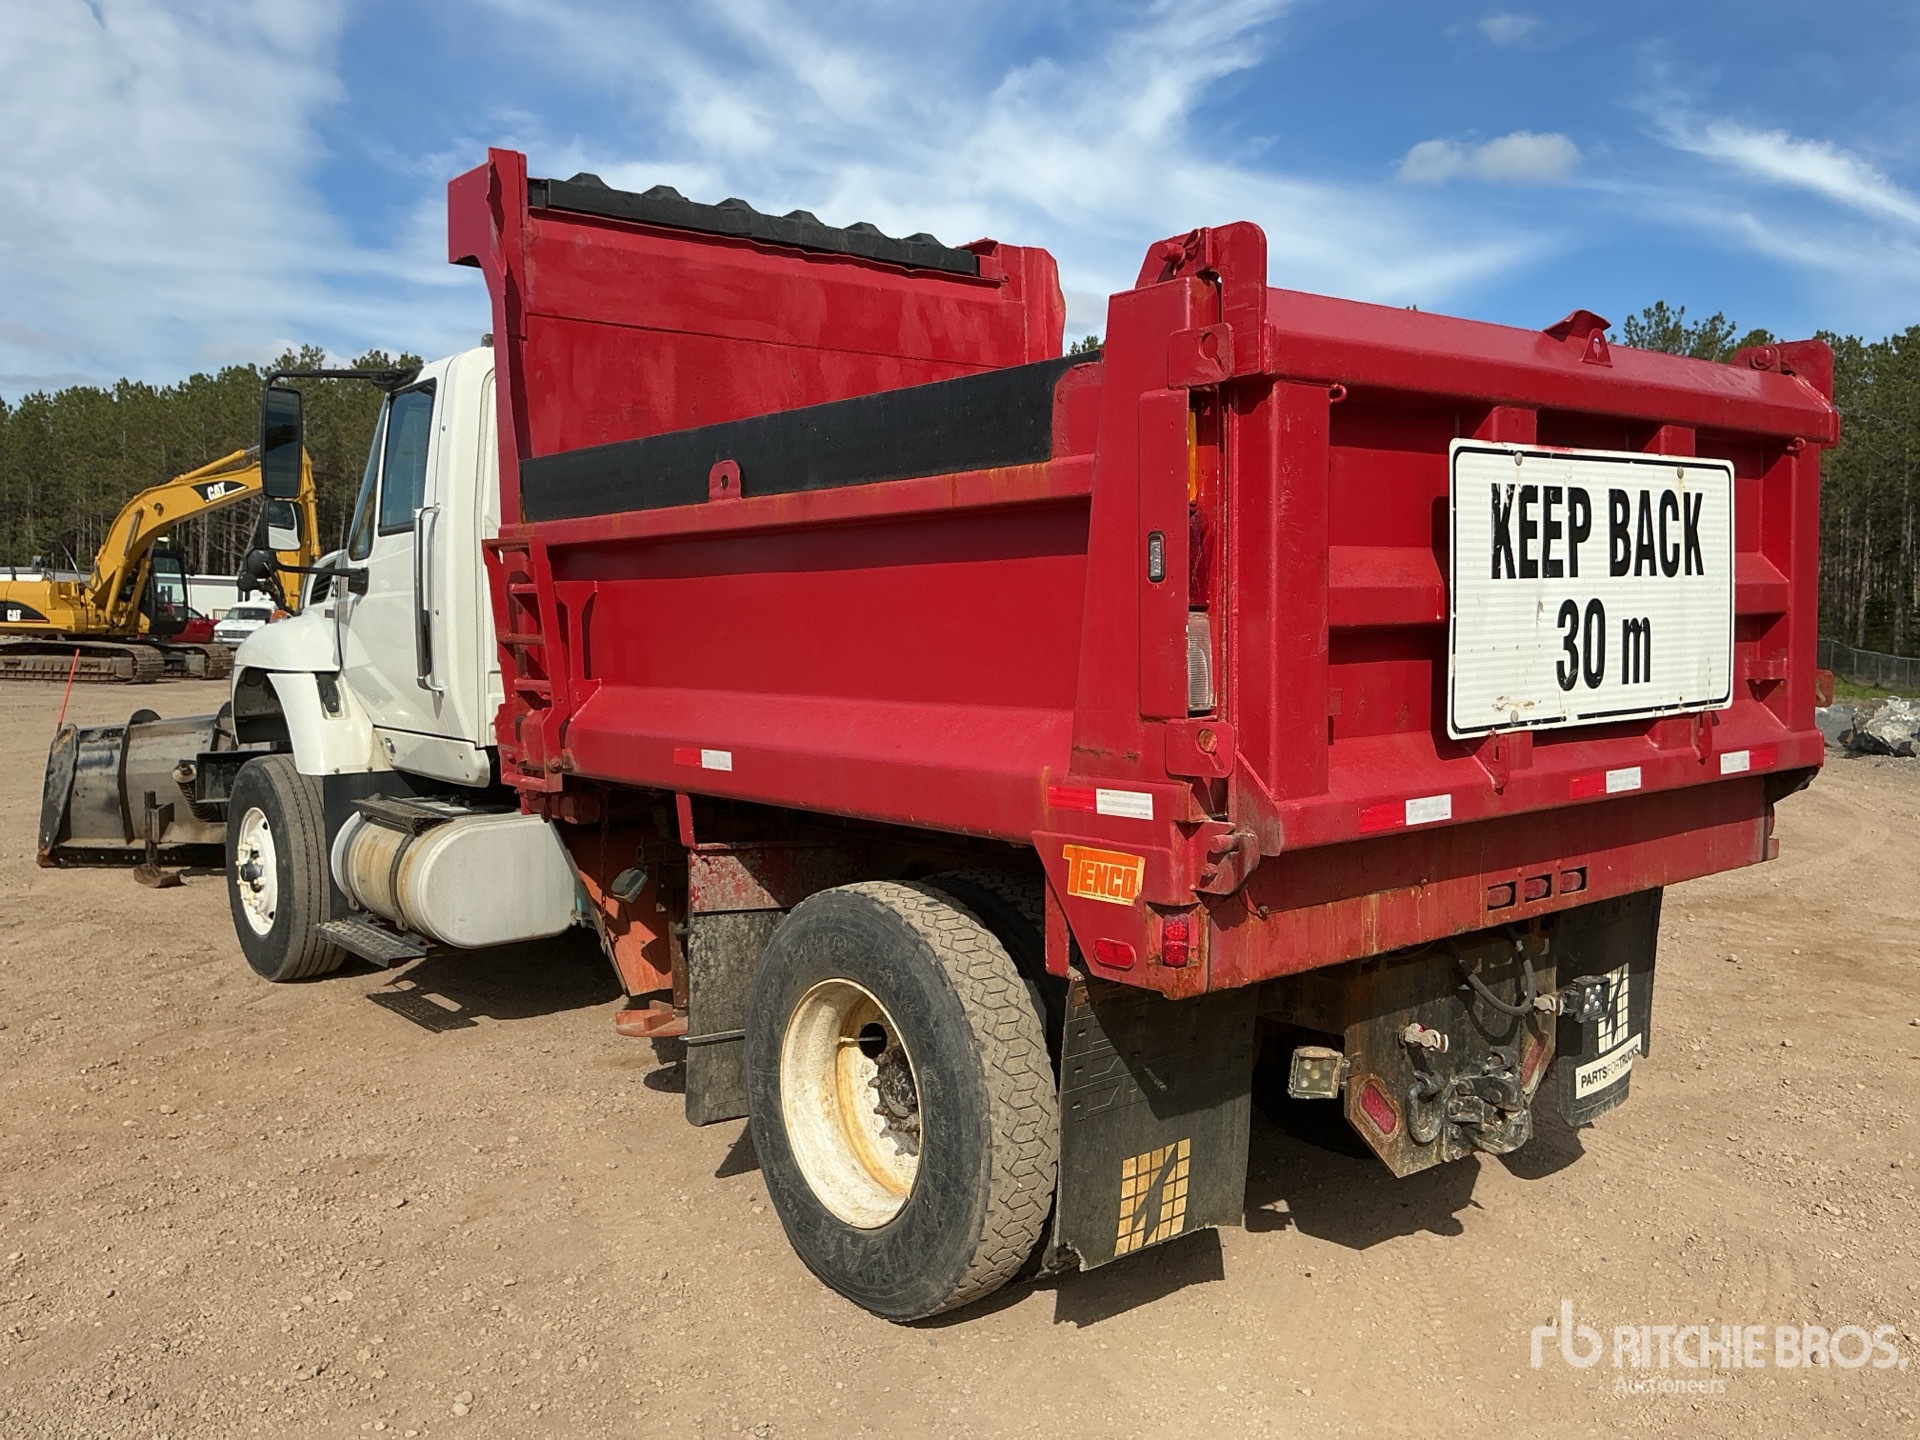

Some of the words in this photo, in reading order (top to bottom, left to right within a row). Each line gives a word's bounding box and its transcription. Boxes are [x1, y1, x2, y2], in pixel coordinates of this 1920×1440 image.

[207, 482, 226, 500] CAT
[1490, 482, 1592, 580] KEEP
[1608, 488, 1705, 578] BACK
[7, 609, 21, 621] CAT
[1555, 597, 1607, 692] 30
[1621, 616, 1652, 686] m
[1064, 846, 1139, 900] TENCO
